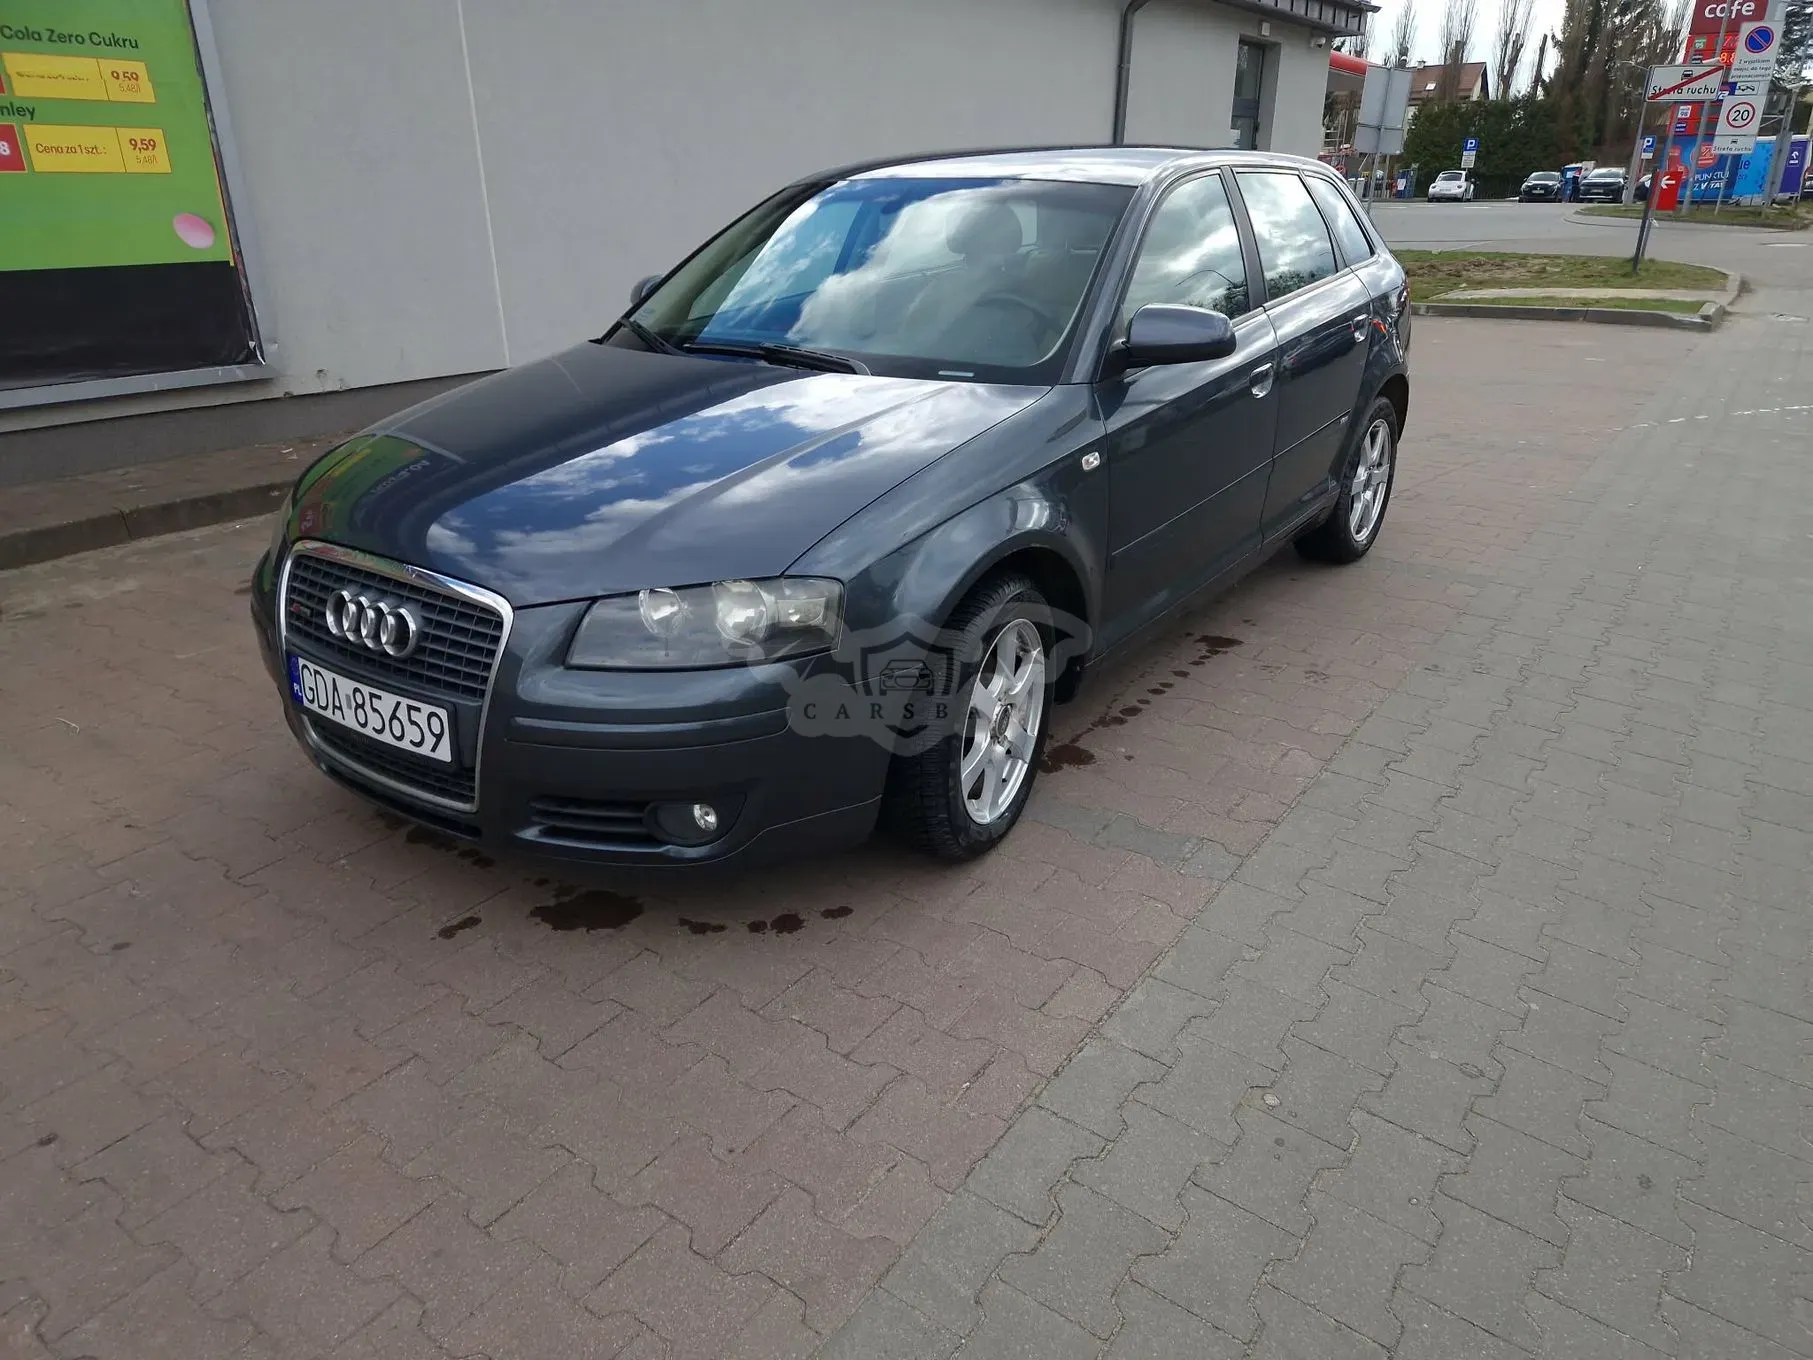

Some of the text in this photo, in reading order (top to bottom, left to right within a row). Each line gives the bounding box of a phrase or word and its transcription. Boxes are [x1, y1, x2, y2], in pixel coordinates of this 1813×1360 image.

[1704, 0, 1756, 19] cafe
[0, 25, 139, 49] Cola Zero Cukru
[1686, 83, 1716, 95] ruchu
[1731, 109, 1750, 122] 20
[35, 142, 63, 154] Cena
[66, 145, 78, 154] za
[129, 138, 157, 154] 9,59
[300, 663, 345, 721] GDA
[352, 687, 445, 753] 85659
